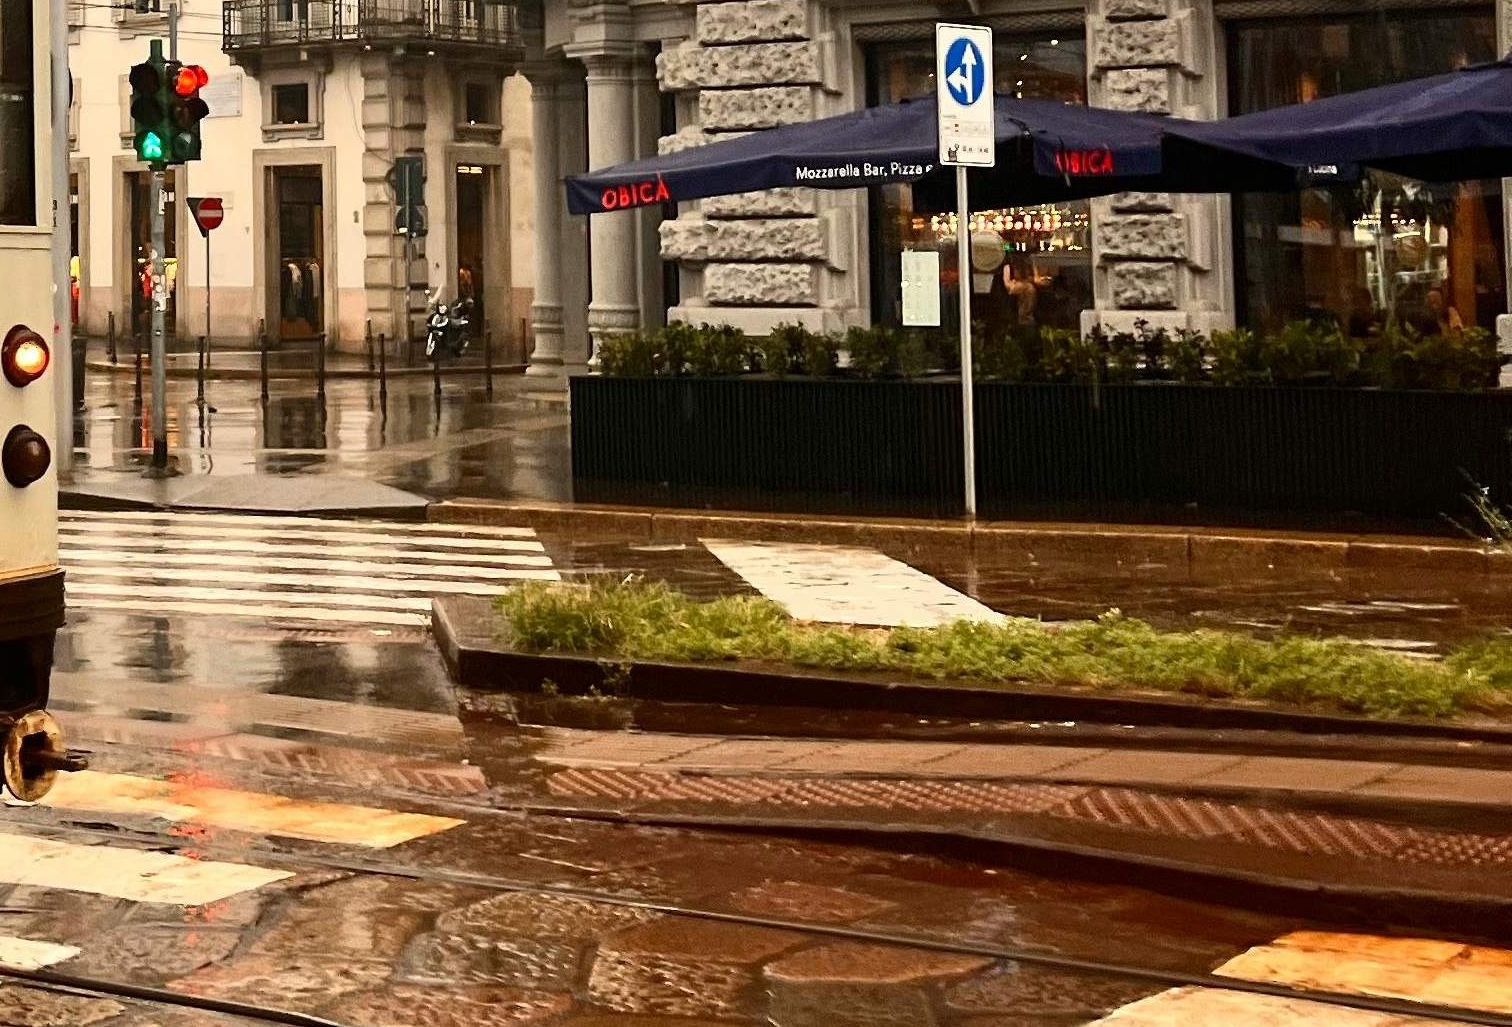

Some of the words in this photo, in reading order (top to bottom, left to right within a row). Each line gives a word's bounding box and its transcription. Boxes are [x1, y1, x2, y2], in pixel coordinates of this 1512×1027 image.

[796, 164, 860, 180] Mozzarella
[864, 162, 888, 176] Bar,
[890, 162, 923, 175] Pizza
